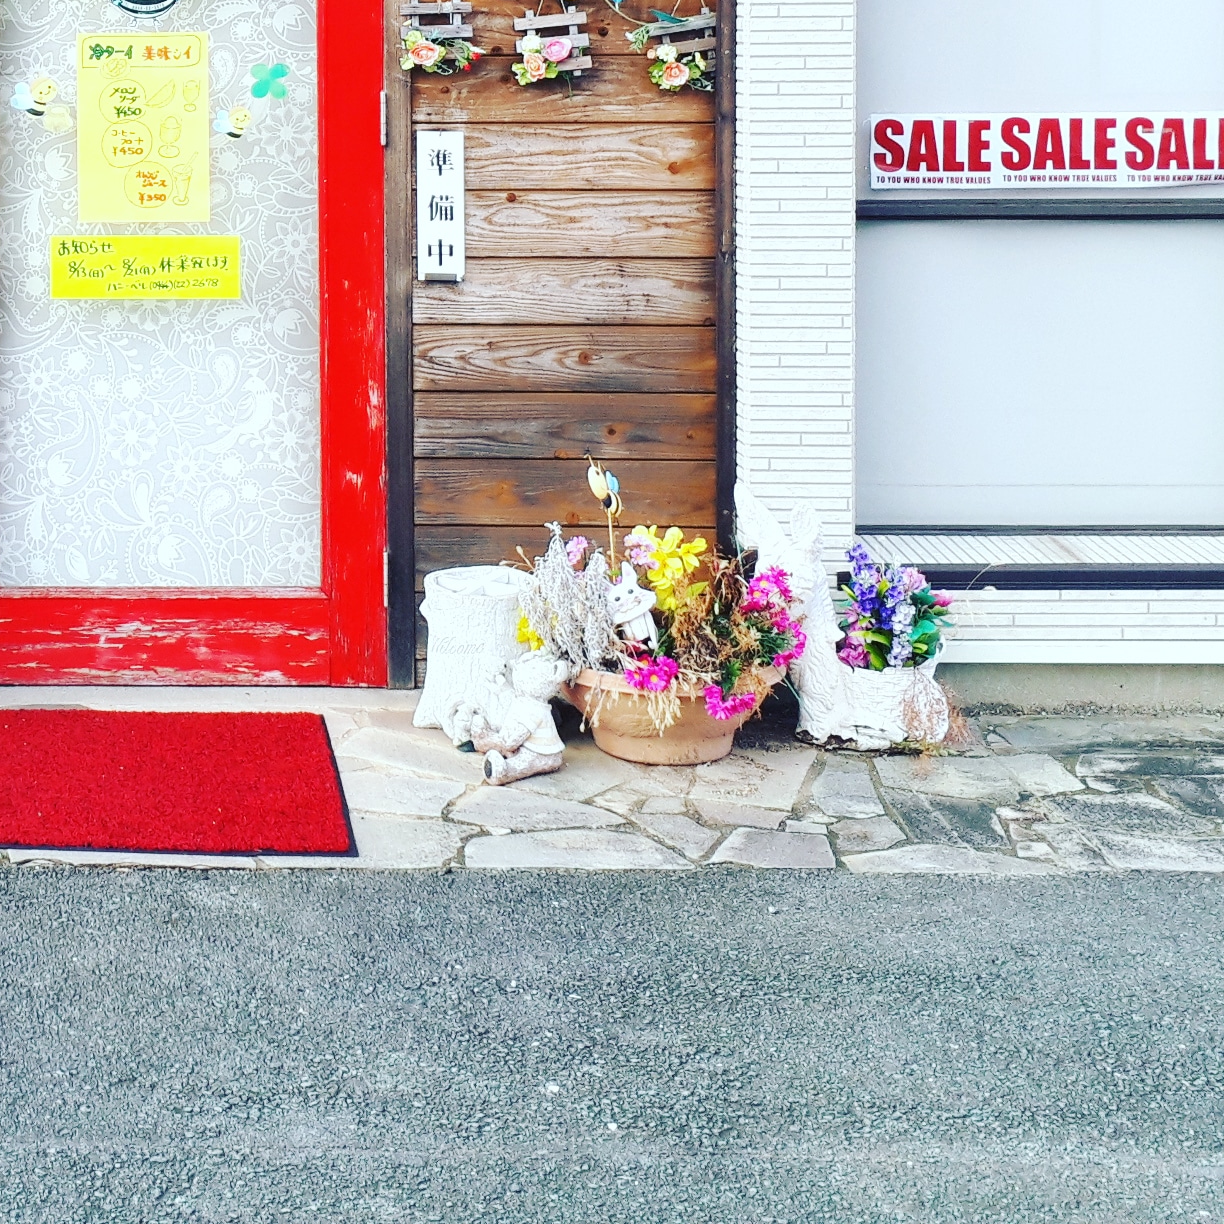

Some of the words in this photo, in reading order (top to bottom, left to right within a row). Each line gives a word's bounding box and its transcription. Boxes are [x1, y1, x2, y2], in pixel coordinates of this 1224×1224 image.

[109, 86, 137, 98] メロン
[113, 105, 143, 119] ¥450
[873, 118, 992, 173] SALE
[1000, 116, 1117, 172] SALE
[1124, 116, 1224, 172] SAL
[112, 146, 144, 157] ¥450
[876, 176, 885, 184] TO
[888, 176, 901, 184] YOU
[904, 176, 920, 184] WHO
[922, 176, 944, 184] KNOW
[946, 176, 963, 184] TRUE
[966, 176, 991, 184] VALUES
[1003, 174, 1012, 182] TO
[1014, 174, 1028, 182] YOU
[1030, 174, 1046, 182] WHO
[1049, 174, 1070, 182] KNOW
[1072, 174, 1089, 182] TRUE
[1091, 174, 1117, 182] VALUES
[1127, 174, 1135, 182] TO
[1138, 174, 1152, 182] YOU
[1172, 174, 1194, 182] KNOW
[138, 192, 167, 205] ¥350
[427, 147, 455, 267] 準備中
[58, 239, 116, 256] お知らせ
